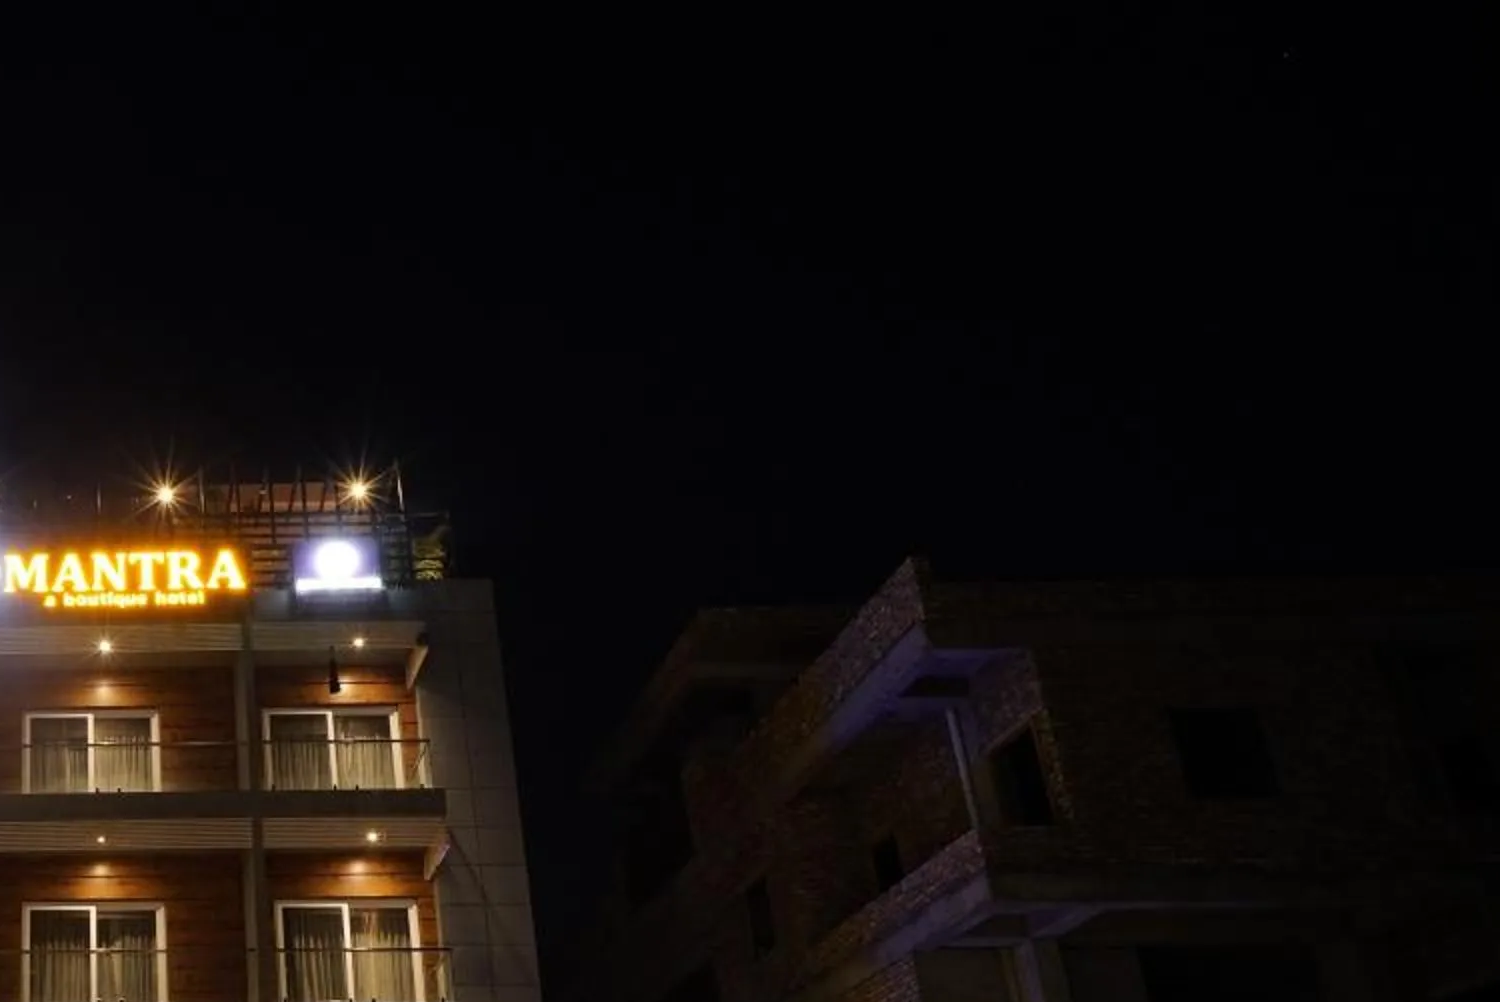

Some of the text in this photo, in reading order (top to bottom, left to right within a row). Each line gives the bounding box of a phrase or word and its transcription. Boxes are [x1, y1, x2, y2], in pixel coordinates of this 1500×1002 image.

[3, 547, 247, 593] MANTRA
[43, 588, 205, 608] a boutique hotel
